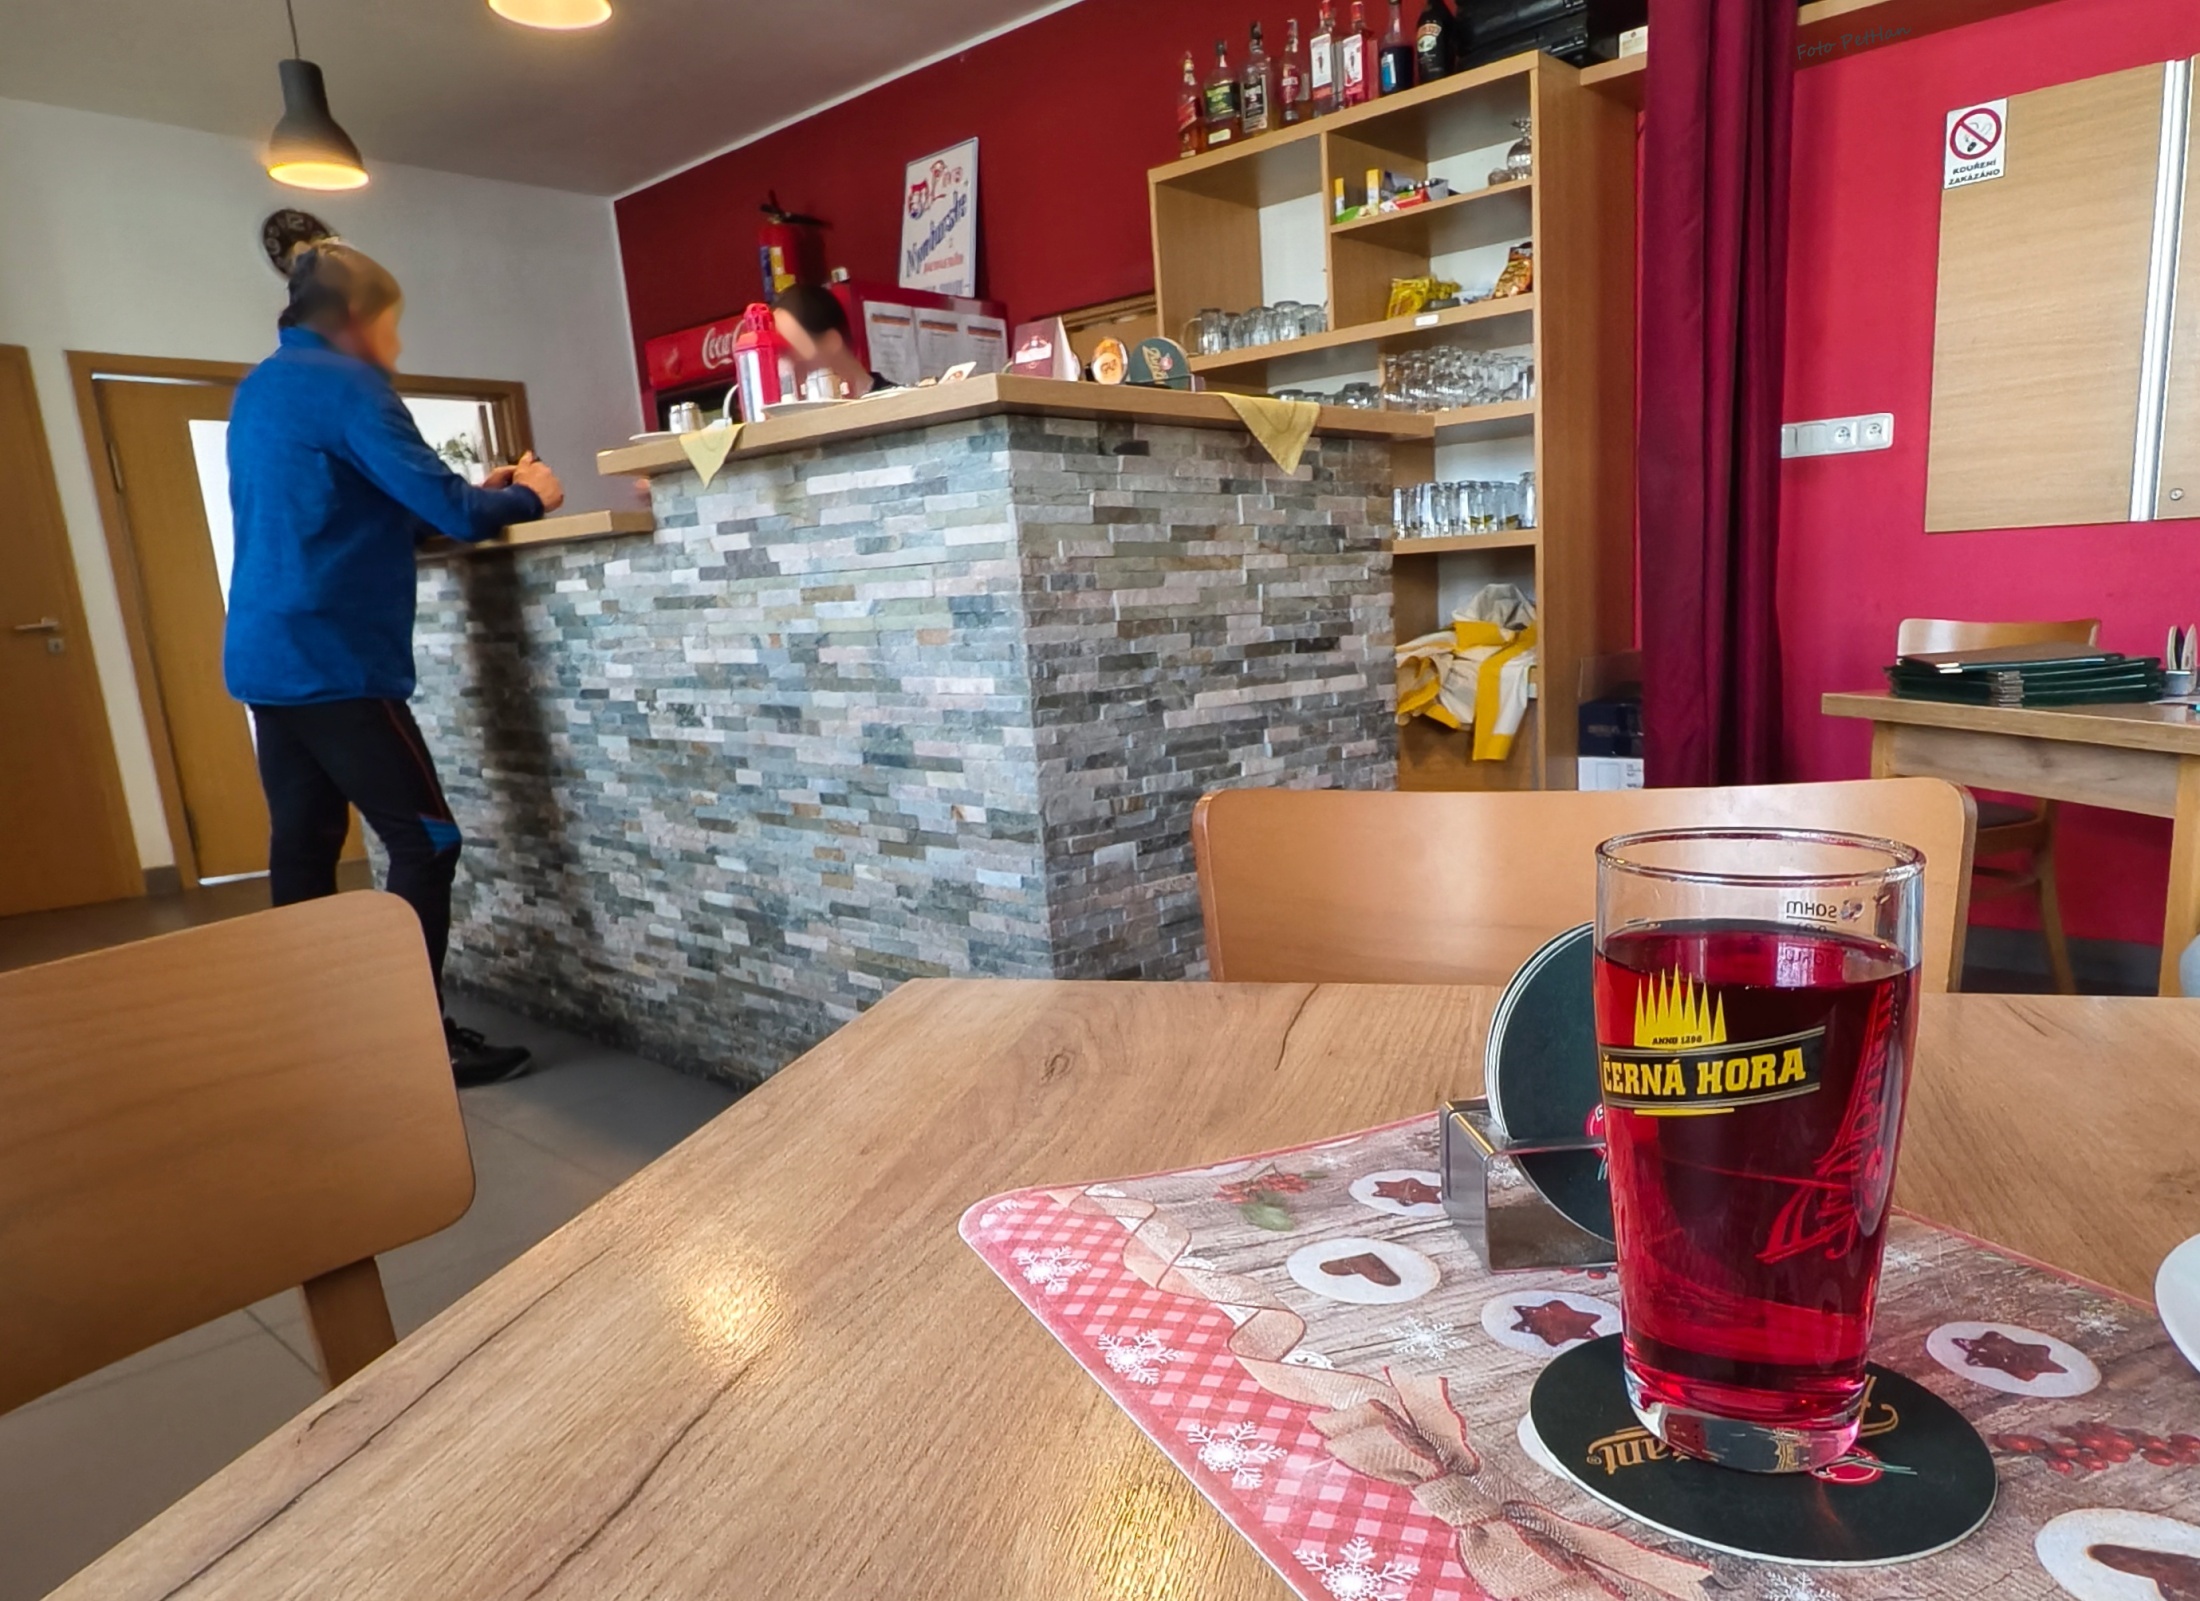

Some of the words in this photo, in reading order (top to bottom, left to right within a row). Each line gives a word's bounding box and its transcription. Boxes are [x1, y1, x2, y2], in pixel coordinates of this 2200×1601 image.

[1652, 1037, 1678, 1045] ANNO
[1603, 1052, 1687, 1096] ČERNÁ
[1697, 1047, 1807, 1096] HORA
